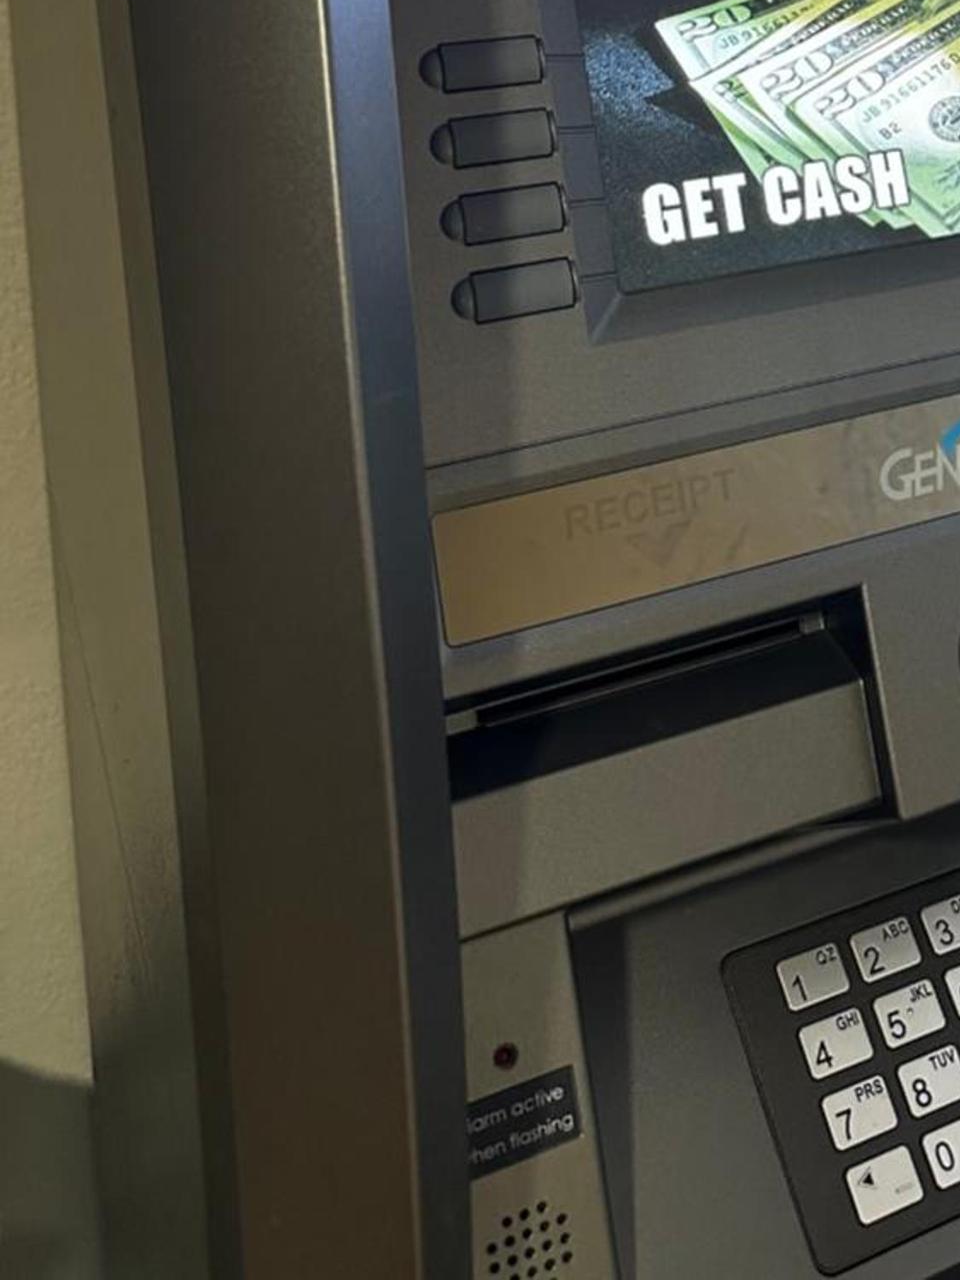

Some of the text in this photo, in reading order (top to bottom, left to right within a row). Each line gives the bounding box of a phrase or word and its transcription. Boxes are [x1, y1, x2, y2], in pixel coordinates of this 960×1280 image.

[814, 69, 888, 120] 20
[642, 172, 747, 245] GET
[762, 149, 911, 226] CASH
[564, 469, 736, 541] RECEIPT
[882, 920, 910, 942] ABC
[935, 919, 954, 945] 3
[815, 947, 838, 965] QZ
[864, 946, 886, 976] 2
[791, 975, 808, 1002] 1
[910, 983, 933, 1003] JKL
[836, 1012, 860, 1031] GHI
[887, 1010, 907, 1039] 5
[816, 1040, 833, 1069] 4
[928, 1049, 956, 1070] TUV
[854, 1078, 884, 1103] PRS
[912, 1078, 932, 1108] 8
[466, 1086, 565, 1134] larm active
[835, 1107, 852, 1141] 7
[468, 1113, 575, 1164] hen flashing
[935, 1141, 955, 1172] 0
